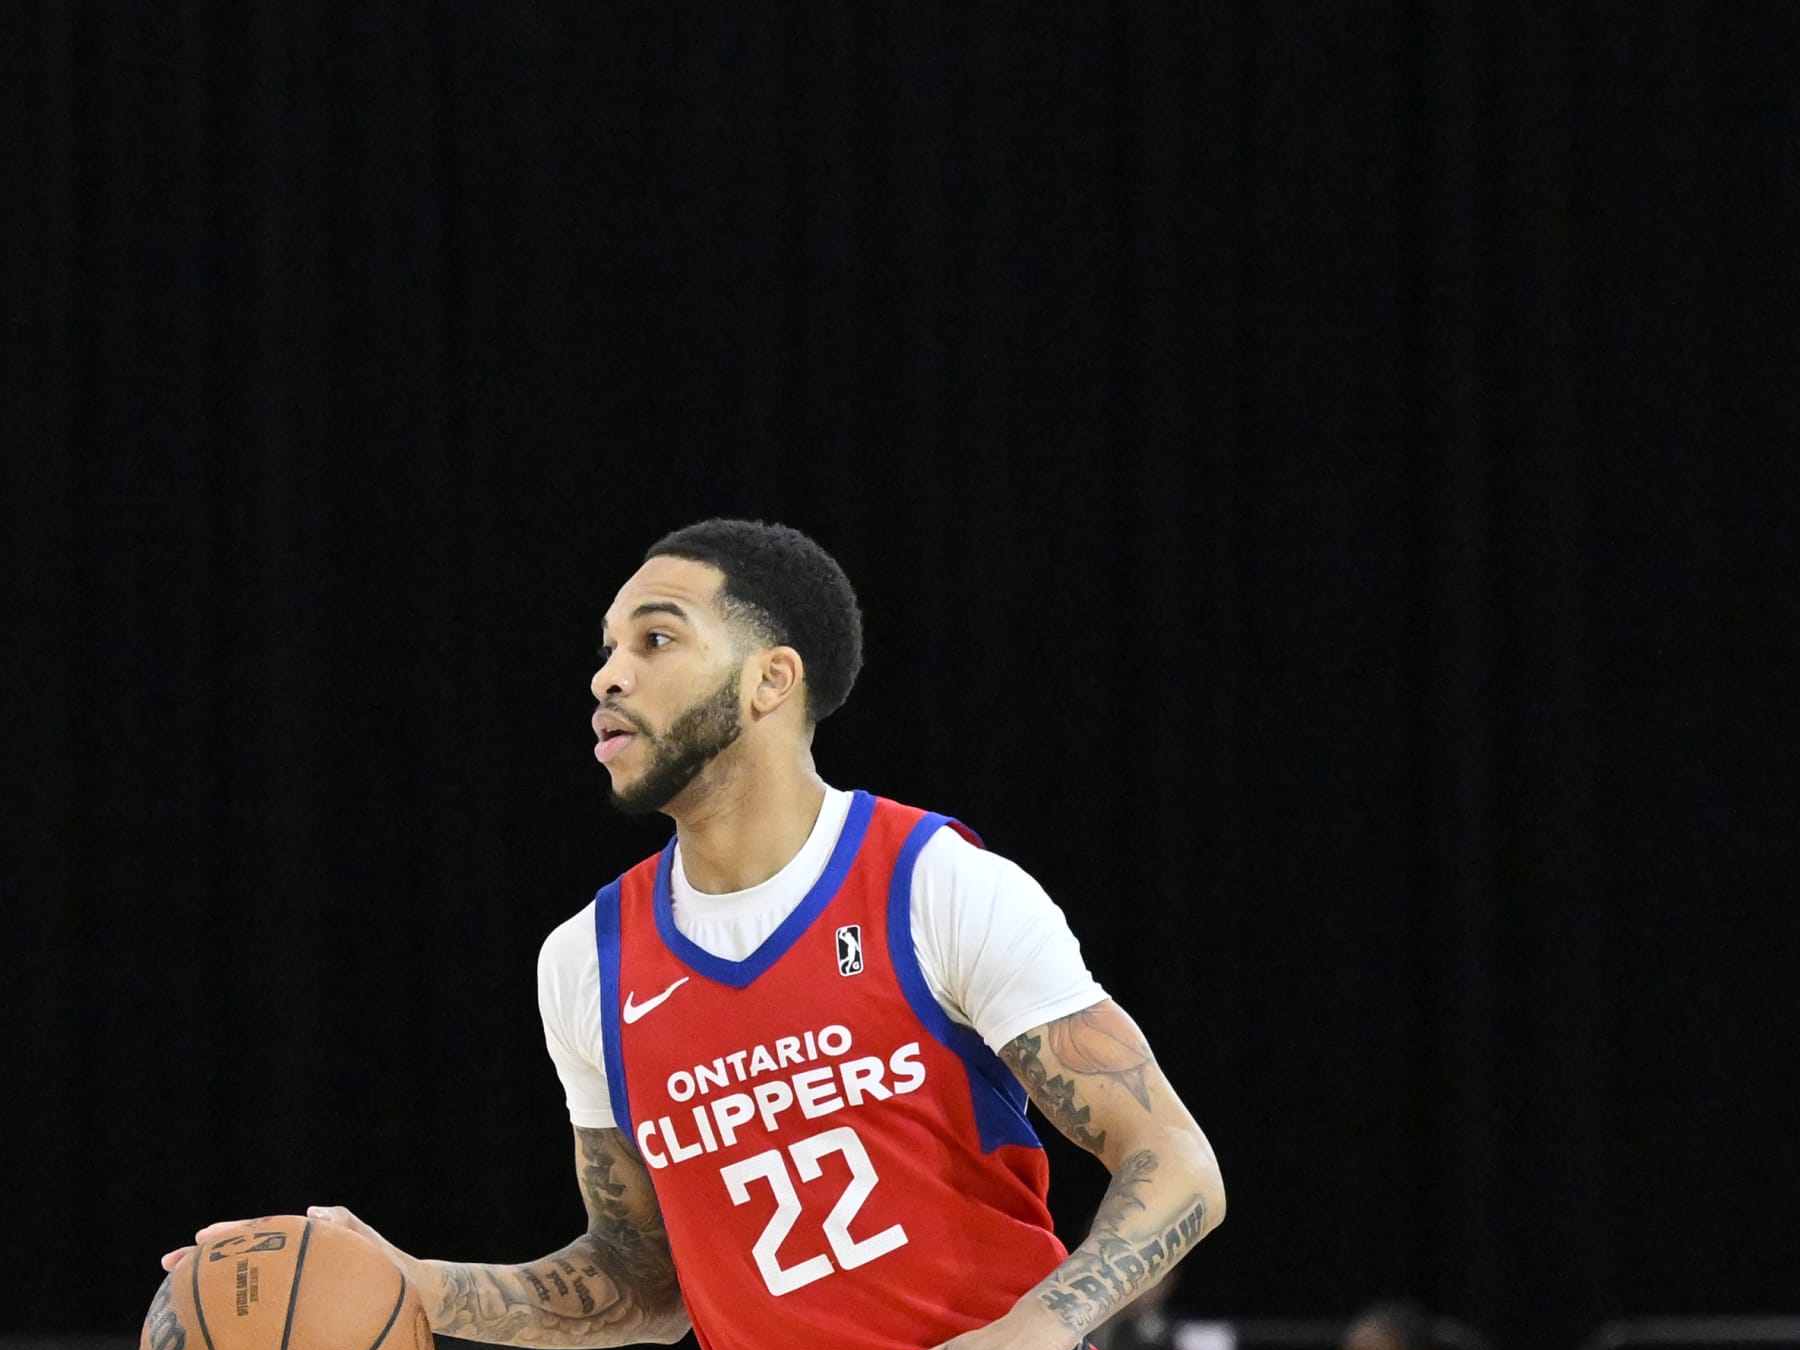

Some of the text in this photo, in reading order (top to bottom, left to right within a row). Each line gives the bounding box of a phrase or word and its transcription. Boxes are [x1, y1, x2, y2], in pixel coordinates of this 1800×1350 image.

[637, 1041, 926, 1169] CLIPPERS
[667, 1024, 853, 1102] ONTARIO
[719, 1126, 909, 1297] 22
